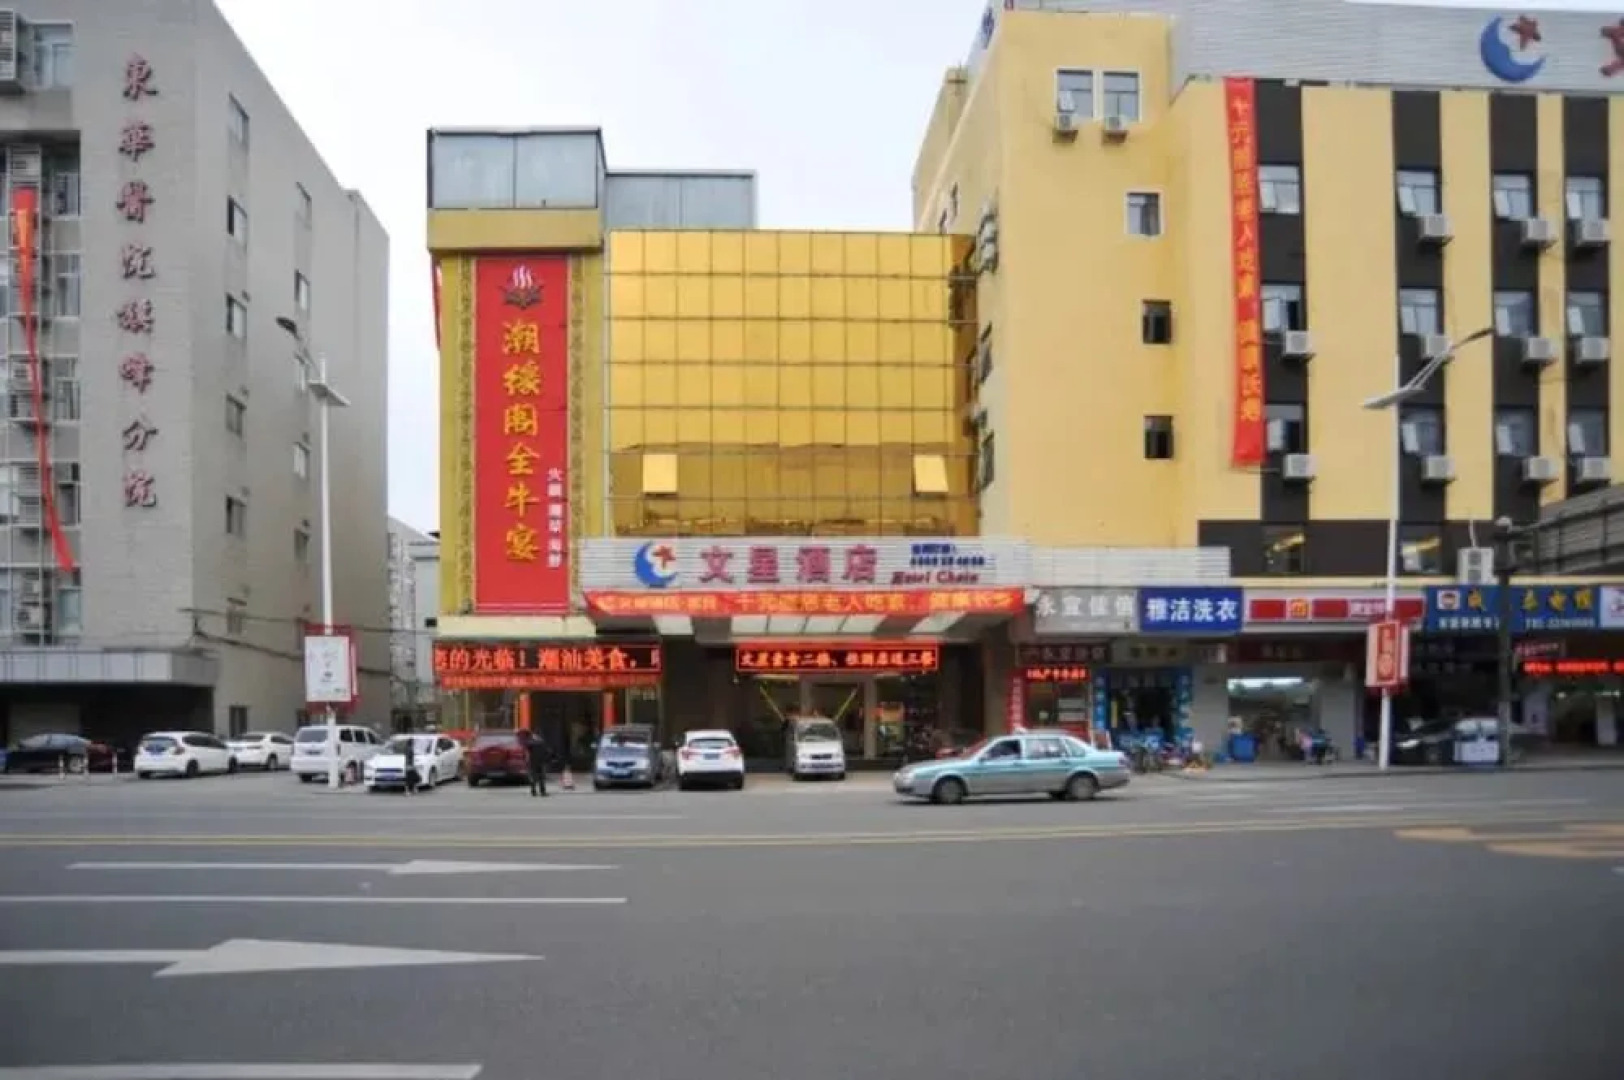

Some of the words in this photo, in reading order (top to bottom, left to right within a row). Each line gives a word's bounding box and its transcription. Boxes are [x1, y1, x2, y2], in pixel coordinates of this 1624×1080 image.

[699, 545, 878, 583] 文星酒店
[1145, 598, 1238, 622] 雅洁洗衣
